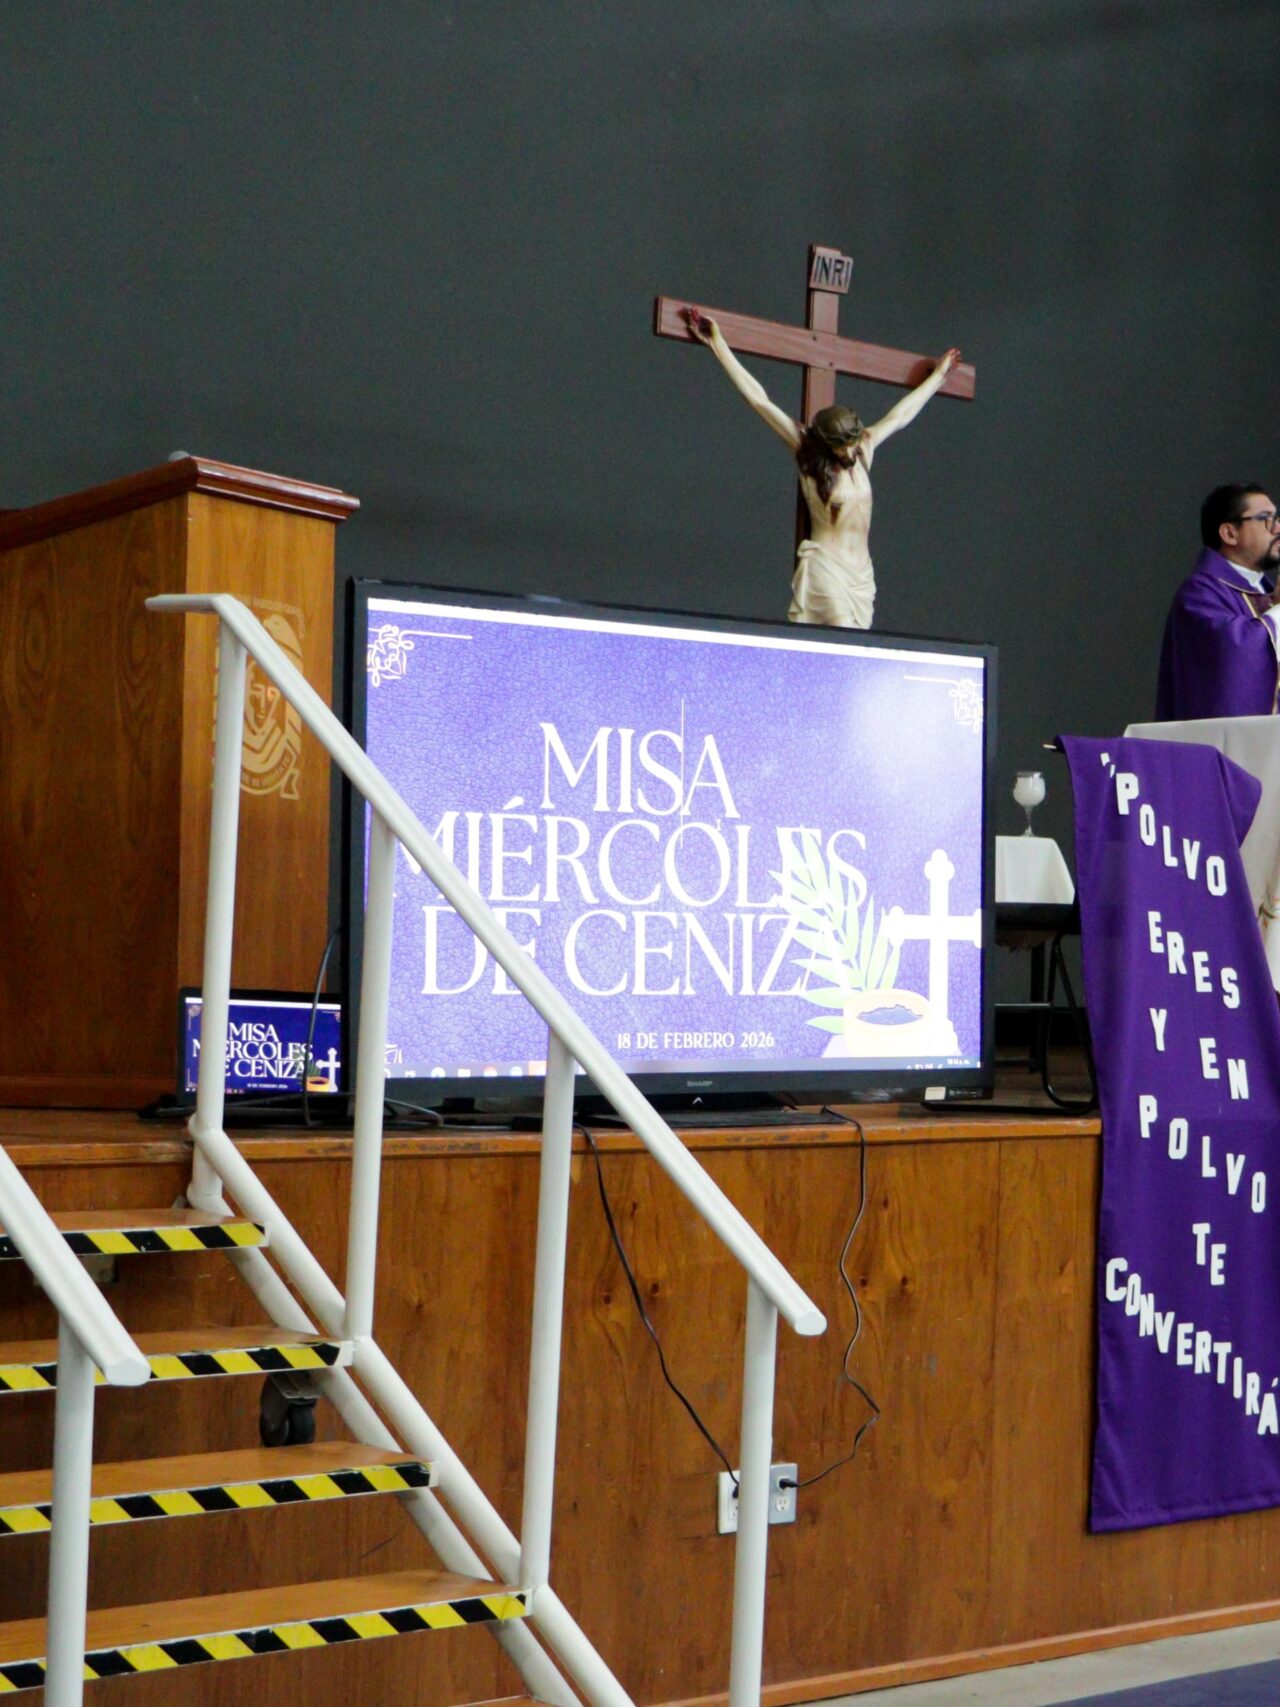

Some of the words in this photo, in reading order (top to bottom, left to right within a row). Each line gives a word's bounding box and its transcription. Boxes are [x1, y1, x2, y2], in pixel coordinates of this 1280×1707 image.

[814, 255, 850, 287] INRI
[539, 722, 741, 818] MISA
[421, 905, 541, 995] DE
[1148, 911, 1240, 1009] ERES
[229, 1022, 279, 1042] MISA
[617, 1032, 631, 1049] 18
[636, 1032, 658, 1049] DE
[664, 1031, 735, 1049] FEBRERO
[741, 1031, 774, 1048] 2026
[1149, 1008, 1167, 1051] Y
[1200, 1038, 1249, 1099] EN
[1139, 1095, 1266, 1213] POLVO
[1192, 1222, 1227, 1286] TE
